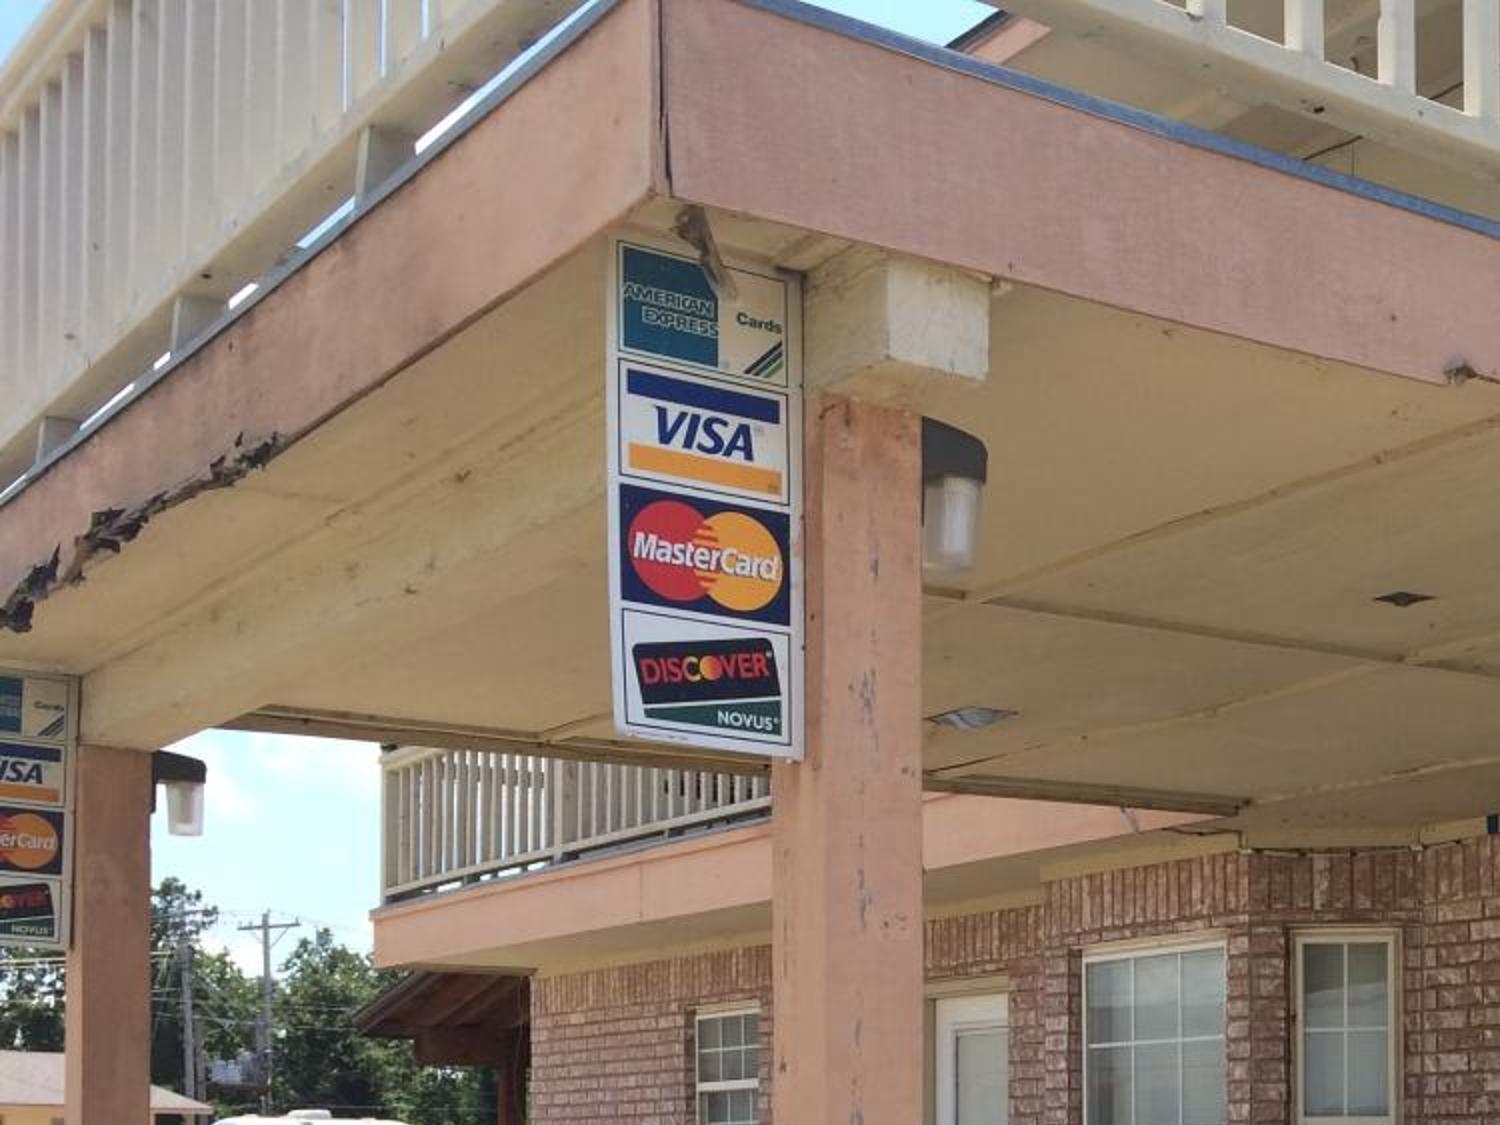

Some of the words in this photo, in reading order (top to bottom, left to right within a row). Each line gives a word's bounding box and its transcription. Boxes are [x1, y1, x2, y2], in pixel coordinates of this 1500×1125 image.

[623, 280, 714, 318] AMERICAN
[642, 305, 719, 337] EXPRESS
[736, 311, 783, 334] Cards
[655, 404, 755, 462] VISA
[633, 531, 780, 581] MasterCard
[639, 652, 770, 684] DISCOVER
[0, 760, 43, 784] ISA
[0, 831, 56, 850] erCard
